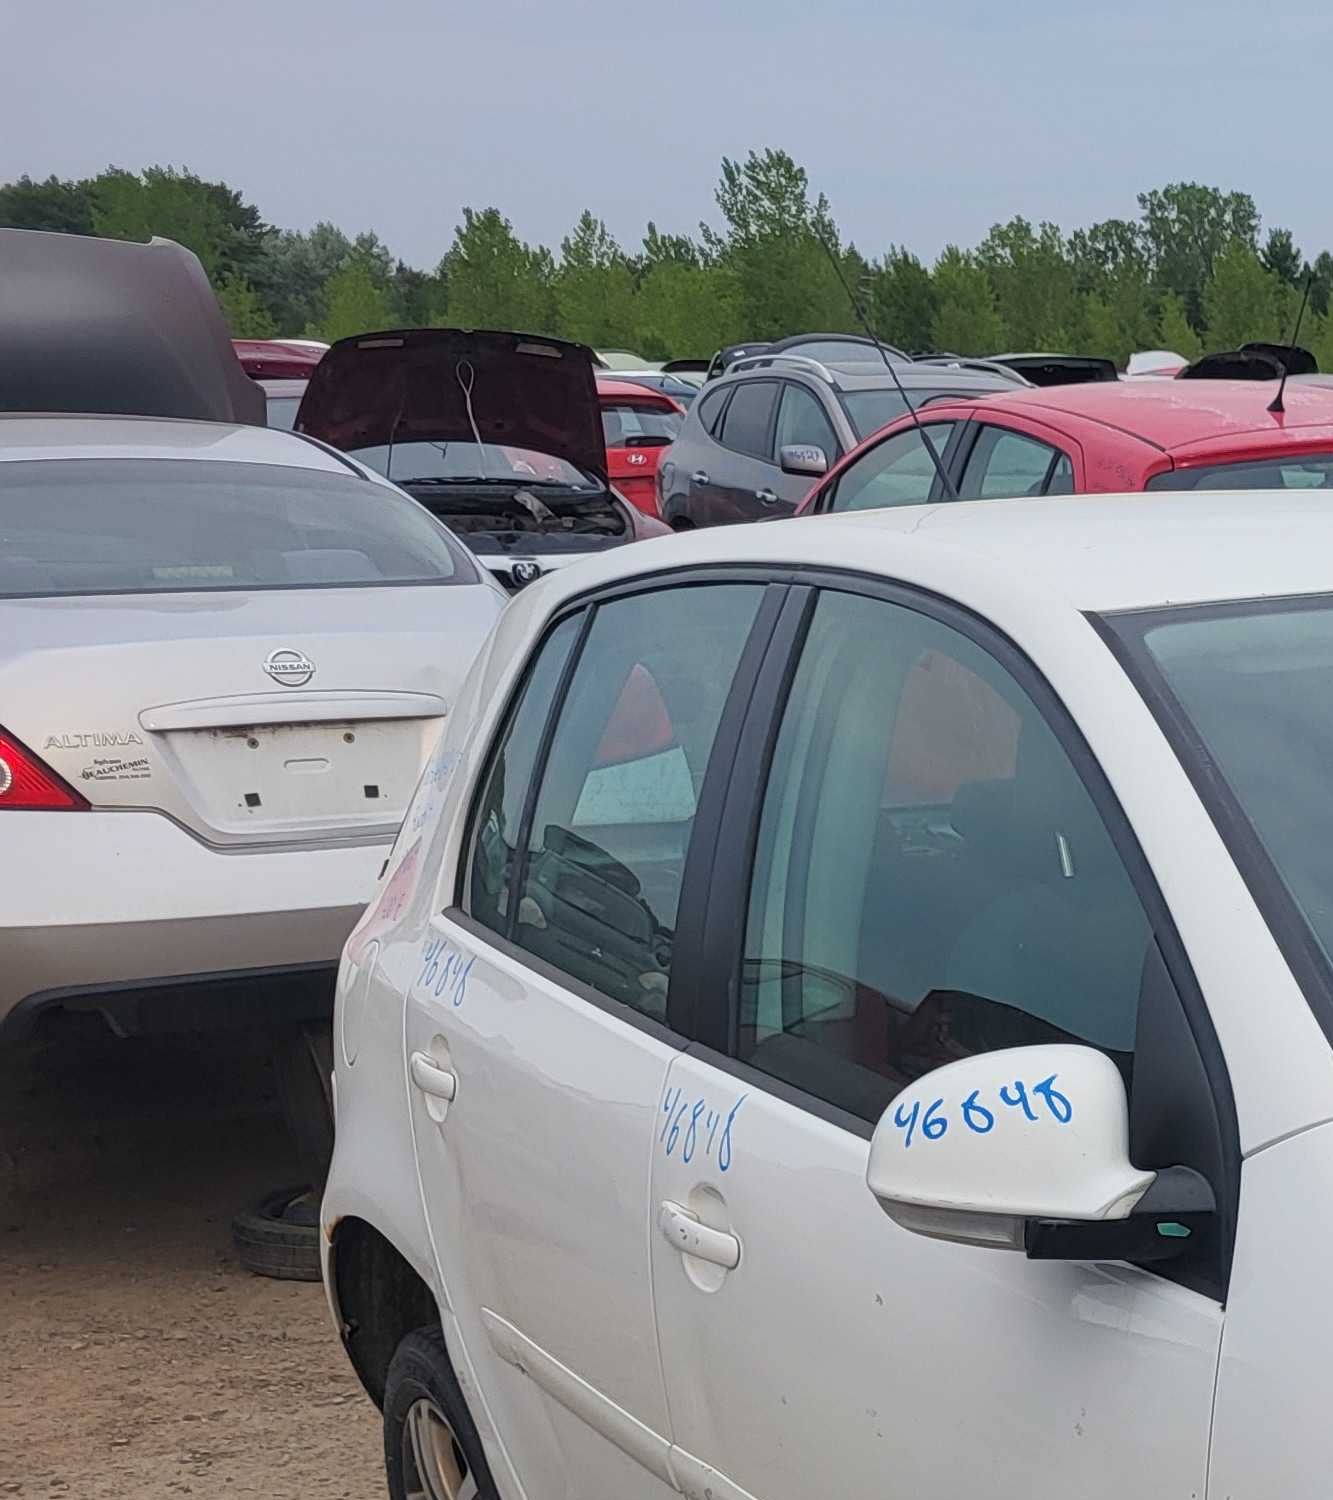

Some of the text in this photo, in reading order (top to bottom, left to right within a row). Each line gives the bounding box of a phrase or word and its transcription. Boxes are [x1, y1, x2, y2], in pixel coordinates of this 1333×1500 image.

[269, 663, 311, 671] NISSAN
[44, 731, 143, 750] ALTIMA
[418, 939, 477, 1007] 46848
[659, 1088, 748, 1172] 46848
[894, 1074, 1072, 1147] 46848
